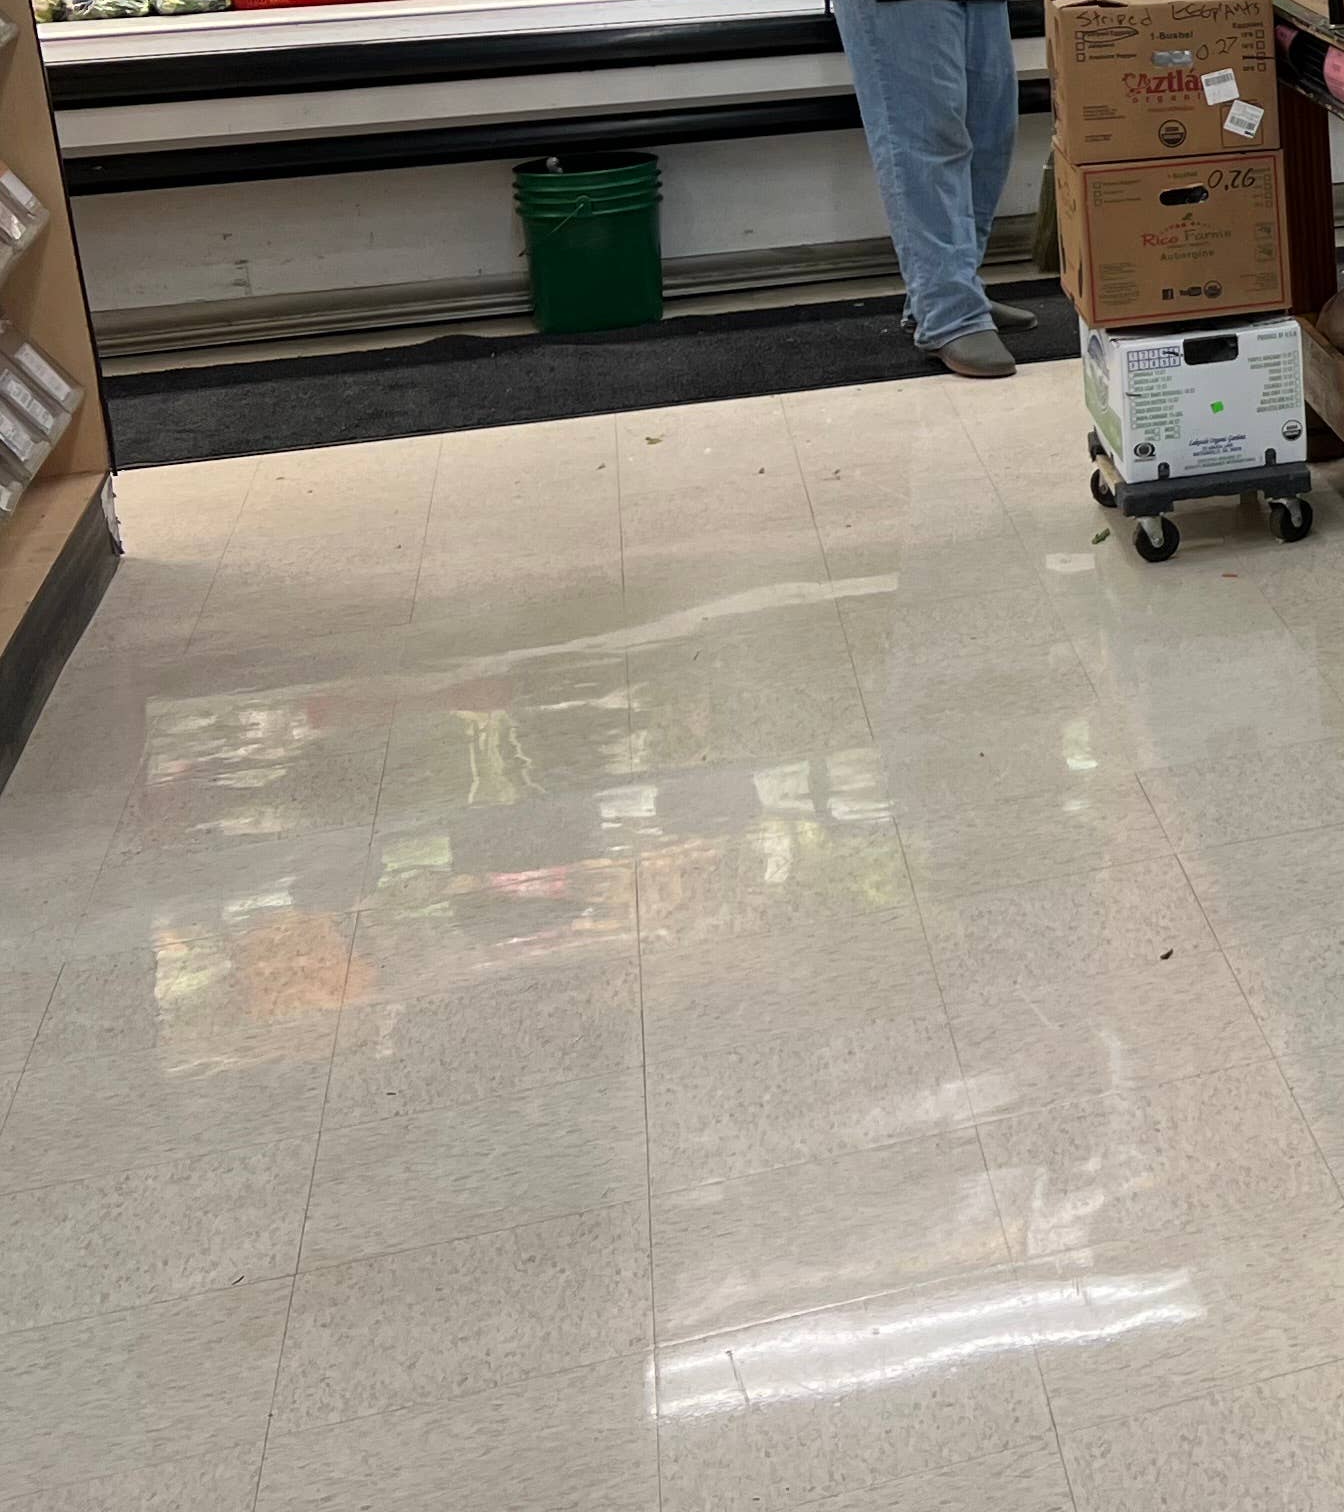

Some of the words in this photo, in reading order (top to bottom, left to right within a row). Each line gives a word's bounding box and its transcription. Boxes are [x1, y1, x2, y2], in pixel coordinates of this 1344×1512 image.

[1121, 67, 1205, 94] Aztlá
[1140, 232, 1180, 248] Rico
[1159, 248, 1216, 263] Aubergine
